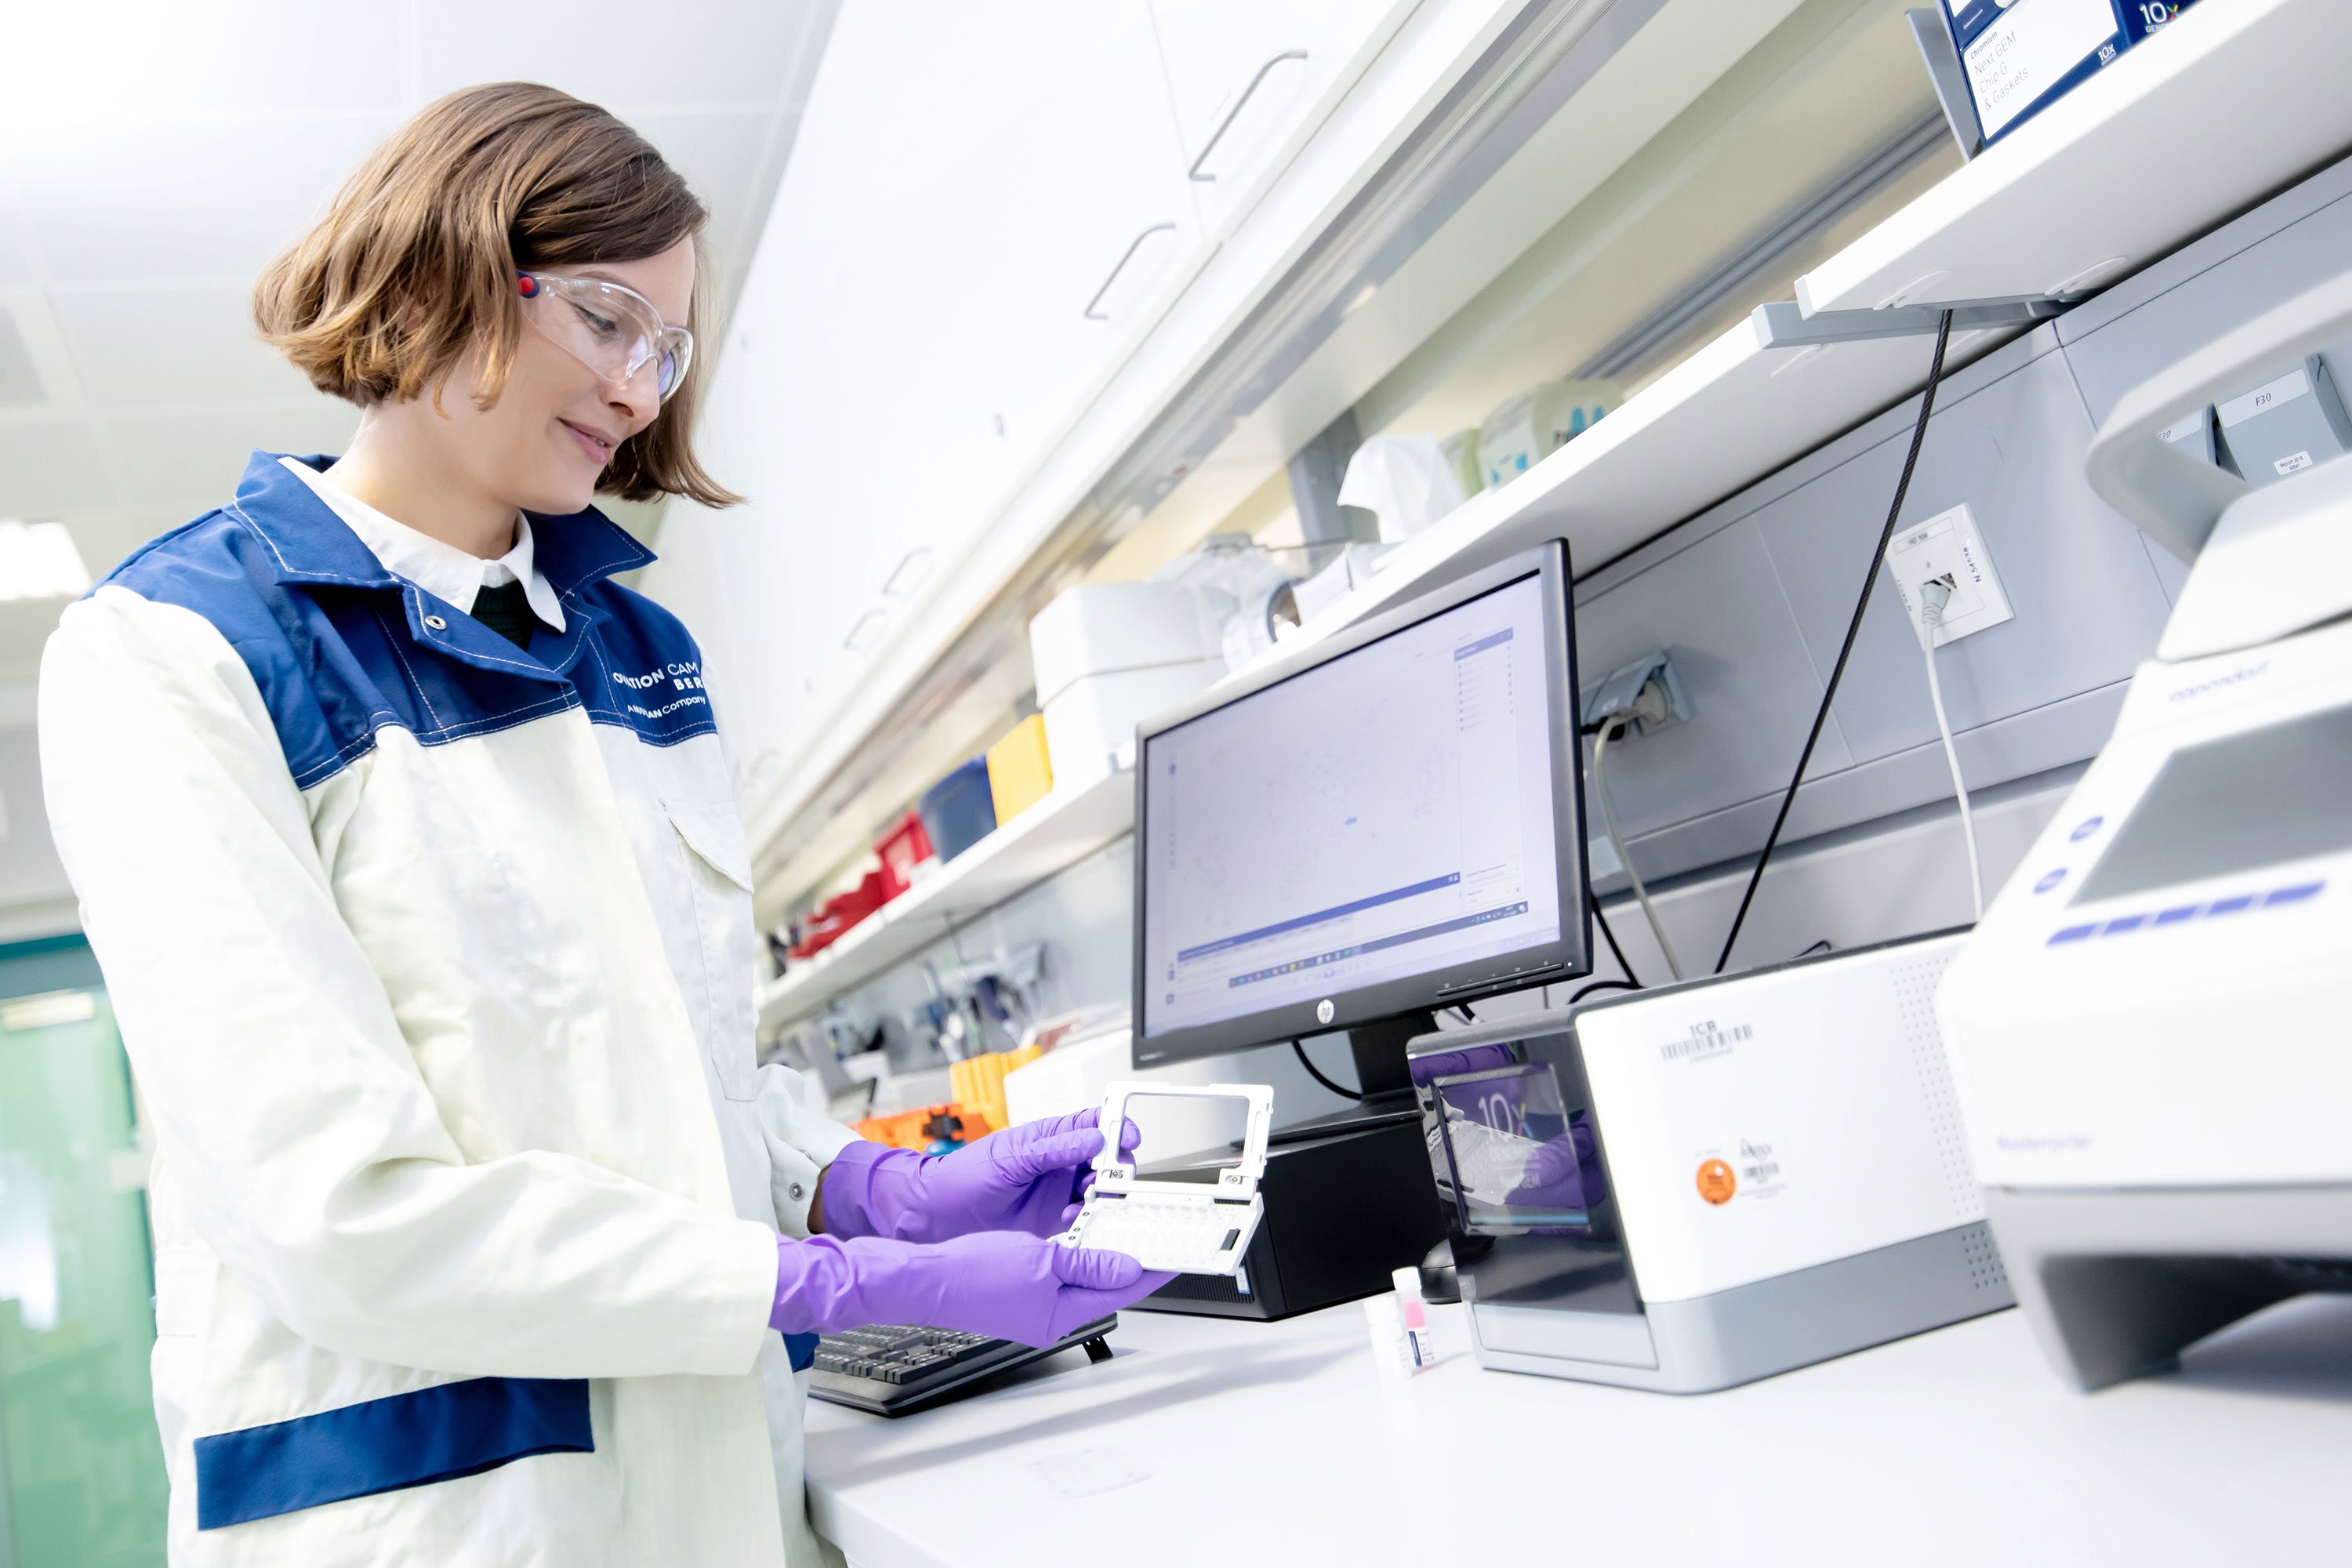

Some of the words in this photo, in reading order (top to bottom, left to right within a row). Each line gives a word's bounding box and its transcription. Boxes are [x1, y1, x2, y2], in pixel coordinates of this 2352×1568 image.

[1970, 31, 1998, 60] Chromium
[1974, 53, 1994, 76] Next
[1994, 31, 2016, 57] GEM
[1980, 72, 1999, 93] Chip
[2000, 62, 2008, 75] G
[1984, 98, 1992, 111] &
[1992, 68, 2029, 103] Gaskets
[2255, 393, 2271, 406] F30
[667, 662, 699, 676] CAM
[662, 696, 706, 714] Company
